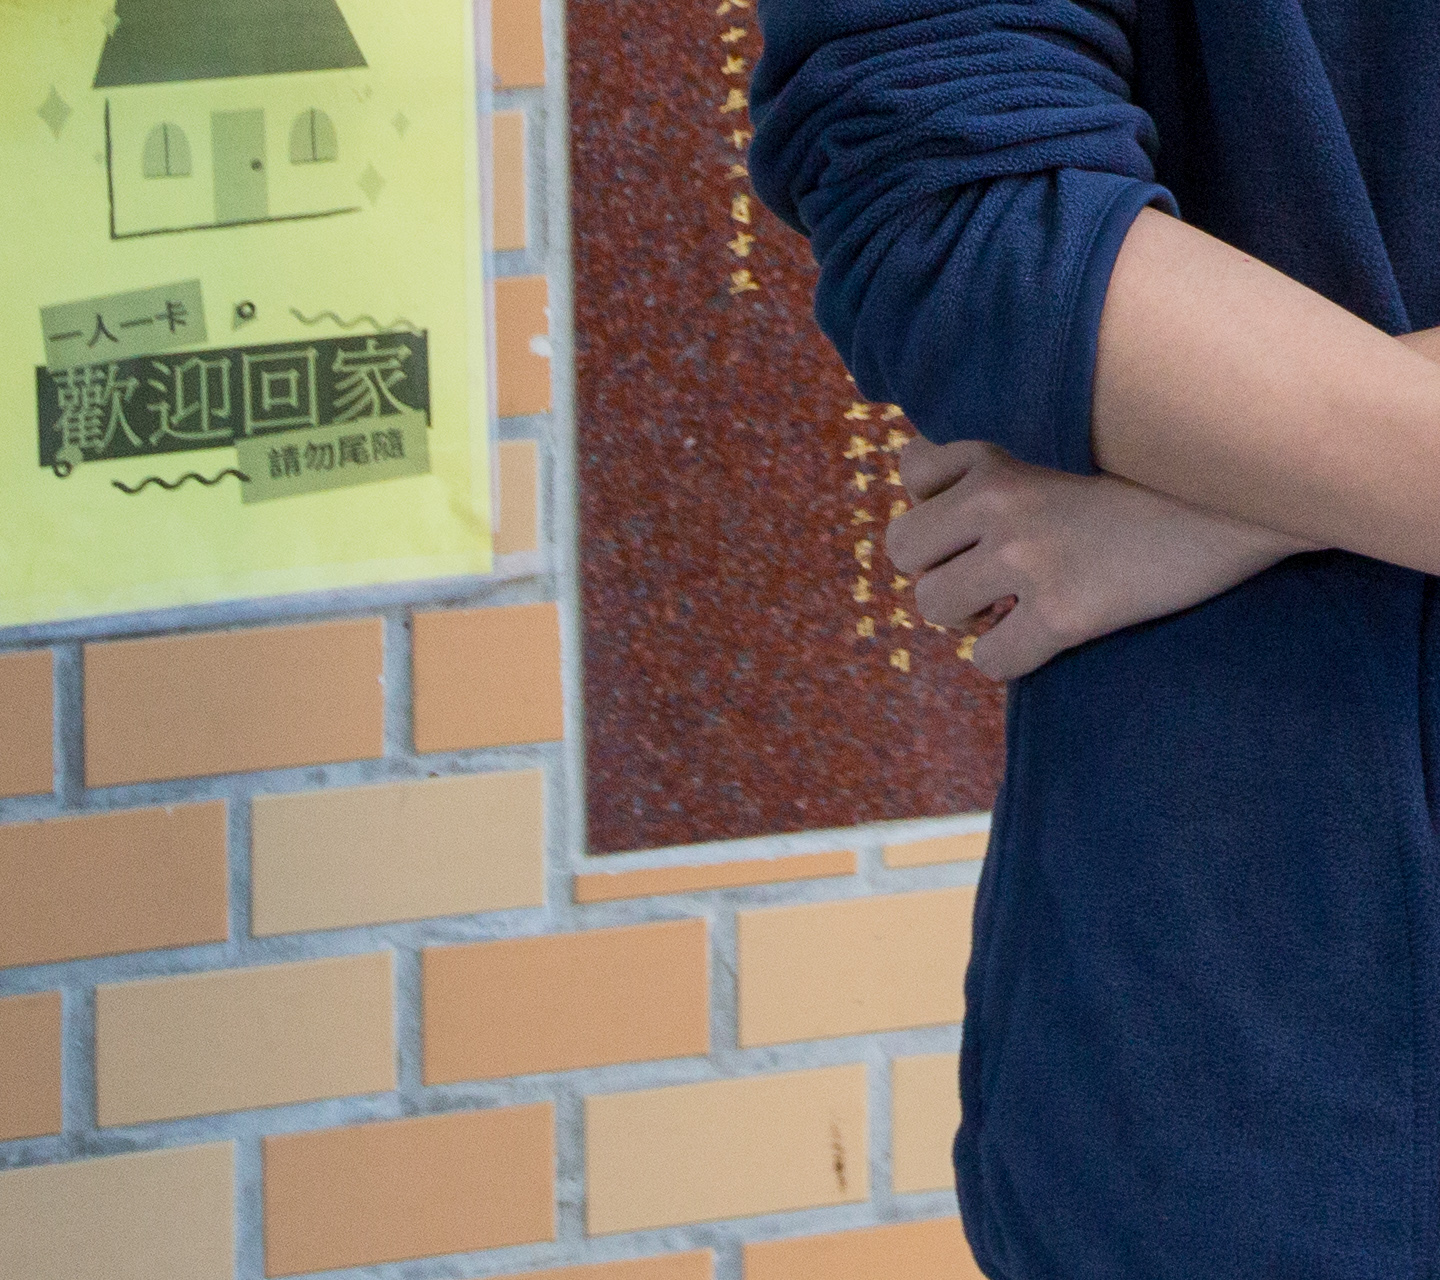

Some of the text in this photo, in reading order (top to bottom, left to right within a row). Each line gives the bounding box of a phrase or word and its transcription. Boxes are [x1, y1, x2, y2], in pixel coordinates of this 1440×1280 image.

[49, 299, 189, 349] 一人一卡
[52, 338, 414, 456] 歡迎回家
[267, 427, 407, 481] 請勿尾隨
